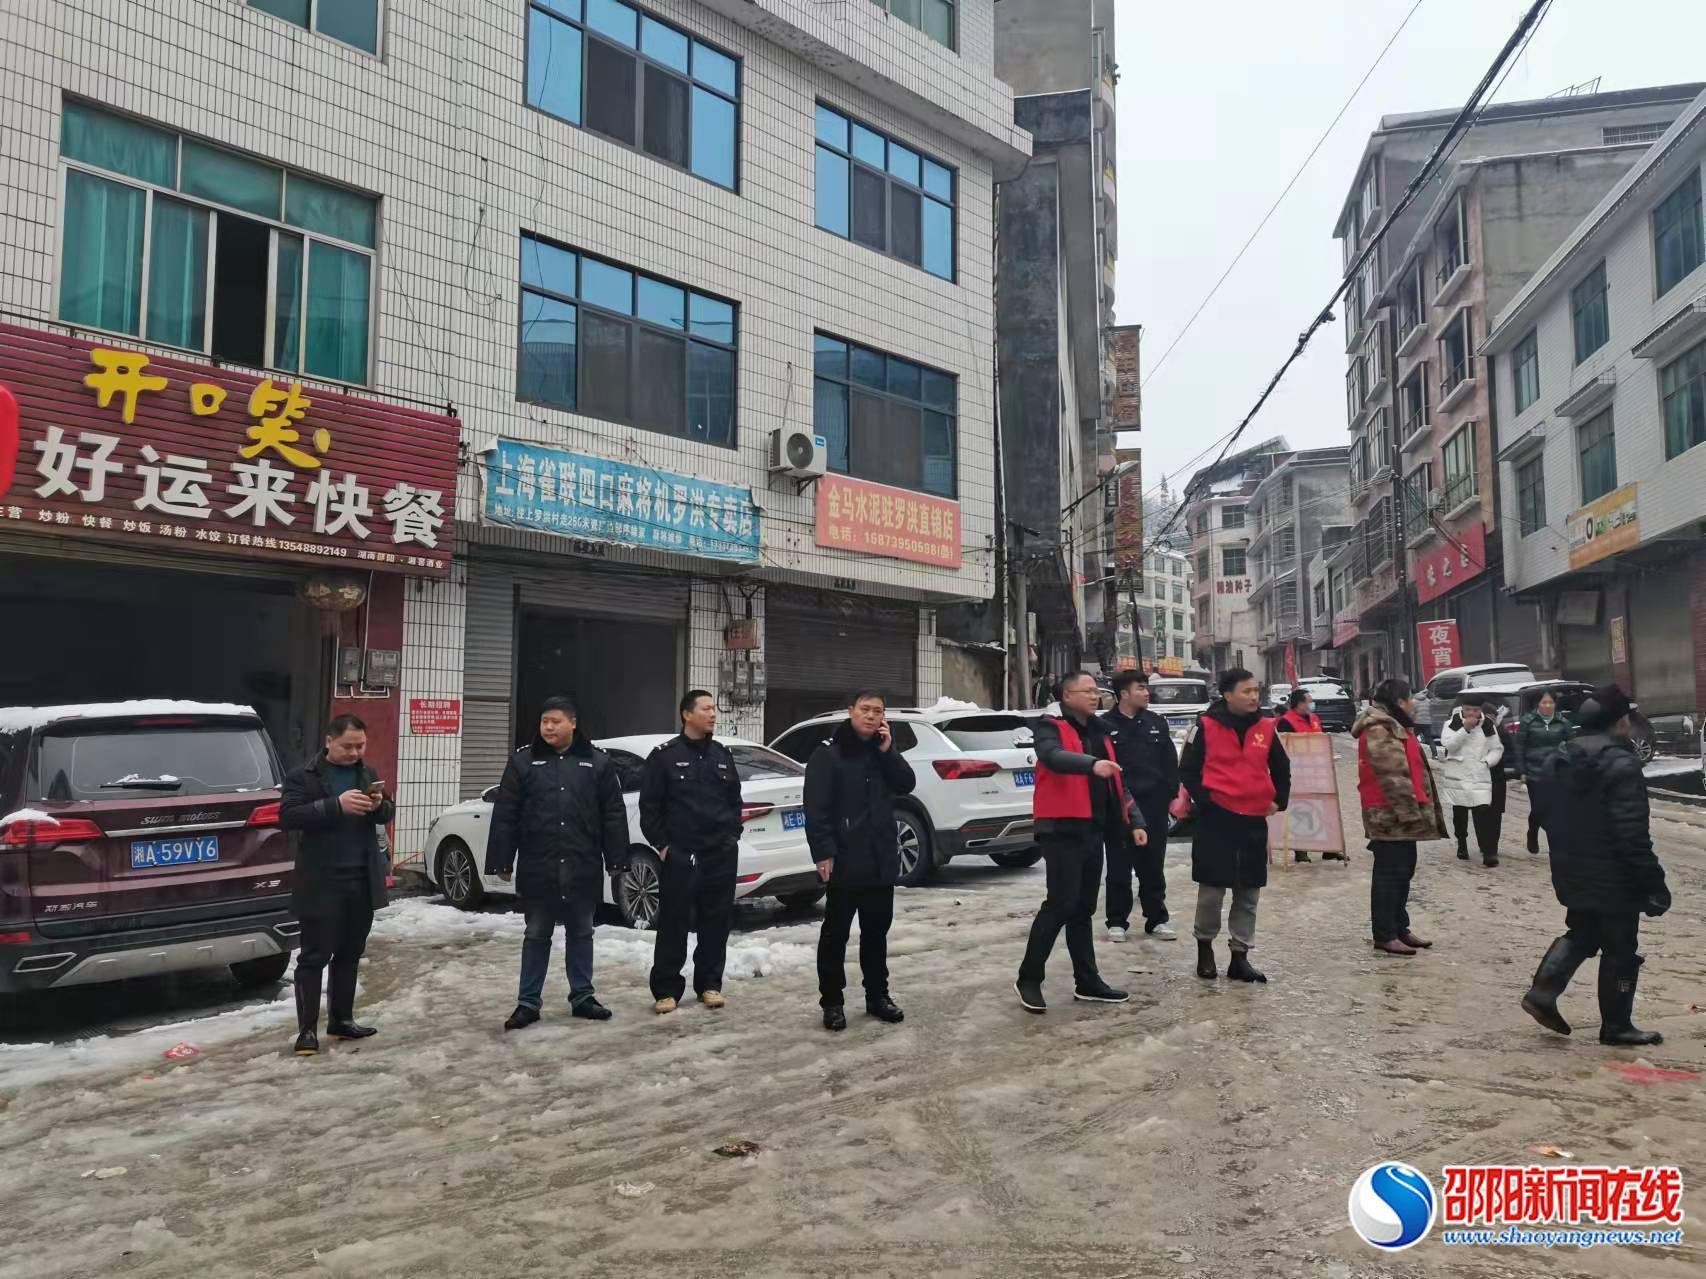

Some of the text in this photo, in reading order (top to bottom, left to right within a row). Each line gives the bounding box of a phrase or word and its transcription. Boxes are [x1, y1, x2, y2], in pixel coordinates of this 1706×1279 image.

[33, 425, 444, 549] 好运来快餐
[828, 483, 954, 542] 金马水泥驻罗洪直销店
[39, 509, 70, 524] 炒粉
[82, 514, 112, 528] 快餐
[122, 519, 151, 533] 炒饭
[159, 524, 187, 538] 汤粉
[195, 528, 221, 542] 水饺
